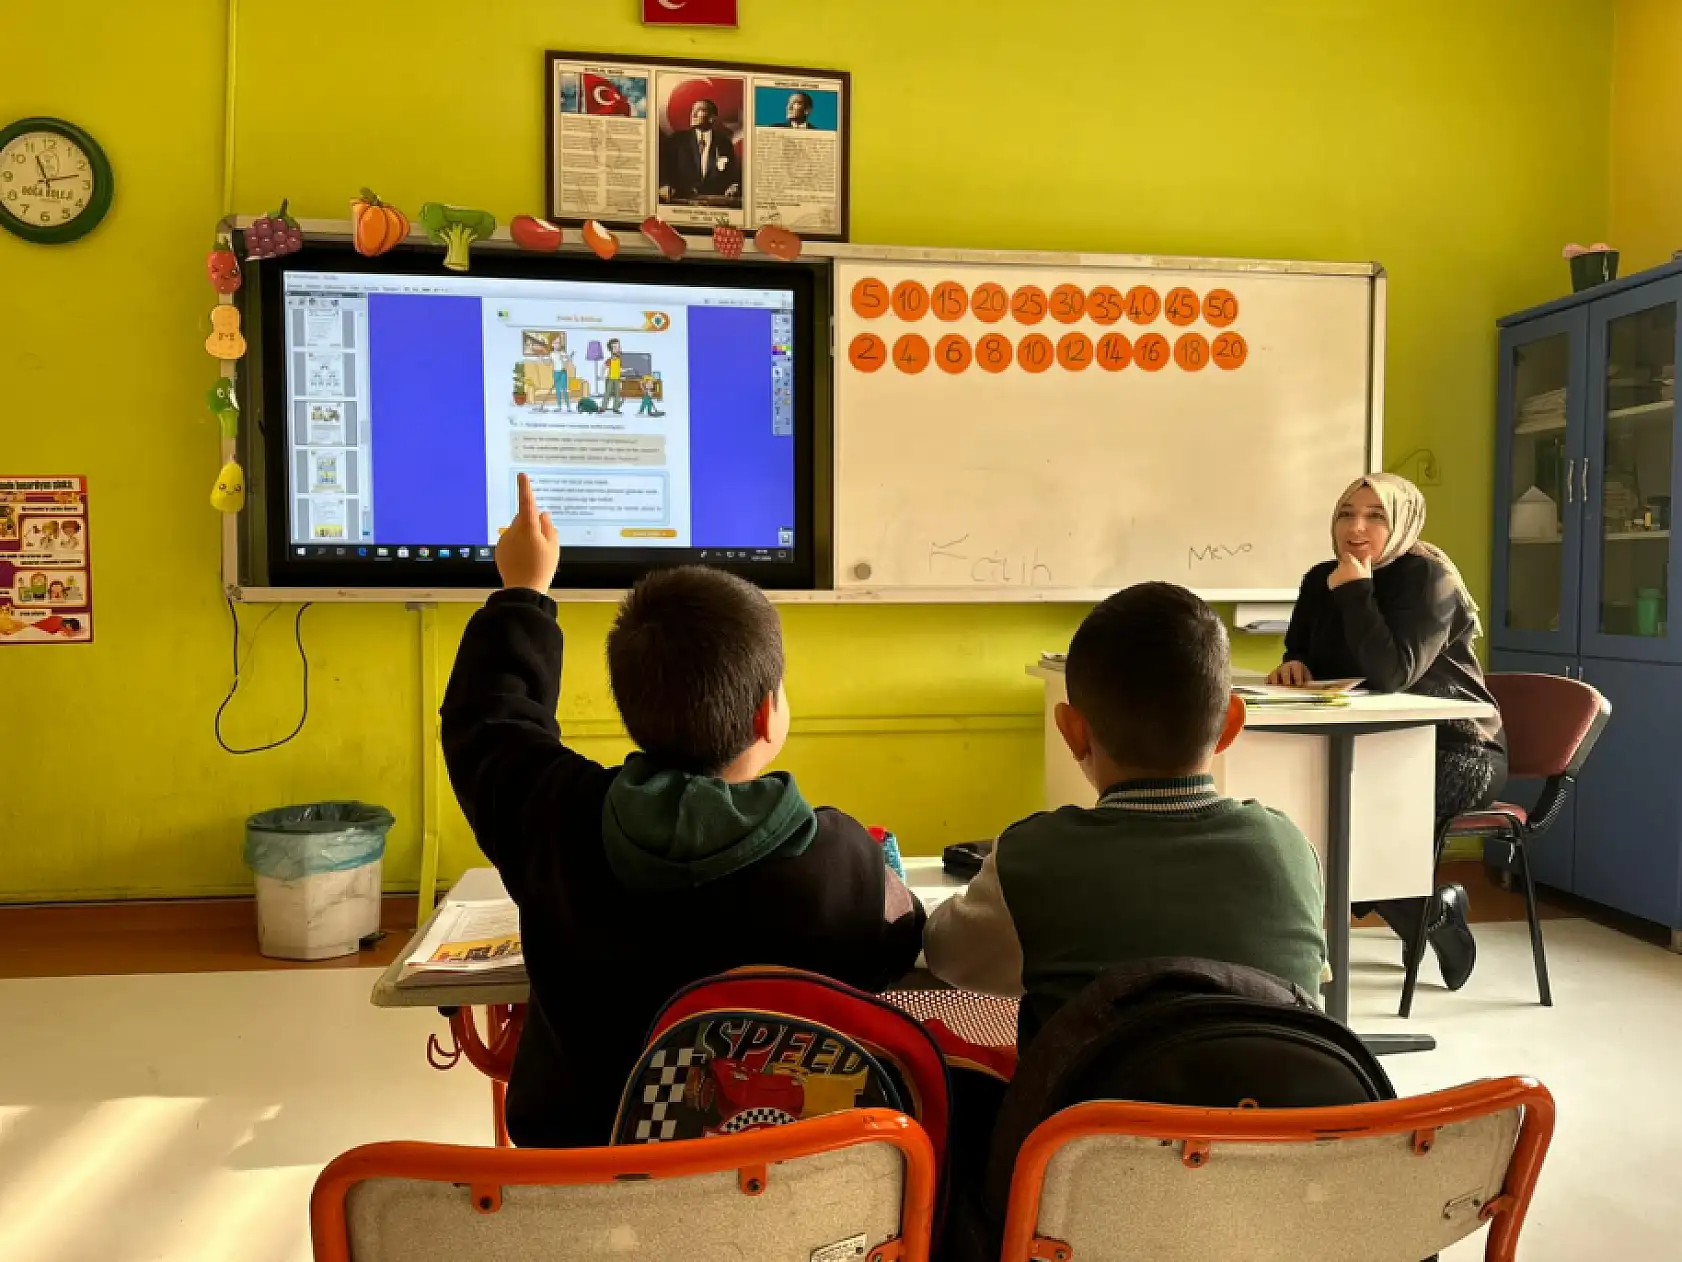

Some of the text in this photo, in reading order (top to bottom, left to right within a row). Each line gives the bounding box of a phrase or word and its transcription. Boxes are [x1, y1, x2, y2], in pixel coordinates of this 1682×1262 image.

[25, 140, 36, 153] 11
[43, 138, 57, 150] 12
[11, 153, 27, 164] 10
[77, 160, 86, 171] 2
[3, 170, 13, 182] 9
[8, 189, 17, 201] 8
[75, 197, 84, 208] 4
[20, 204, 30, 215] 7
[62, 207, 71, 219] 5
[41, 211, 51, 222] 6
[860, 283, 1238, 321] 5 10 15 20 25 30 35 40 45 50
[857, 337, 1243, 365] 2 4 6 8 10 12 14 16 18 20
[698, 1018, 869, 1078] SPEED
